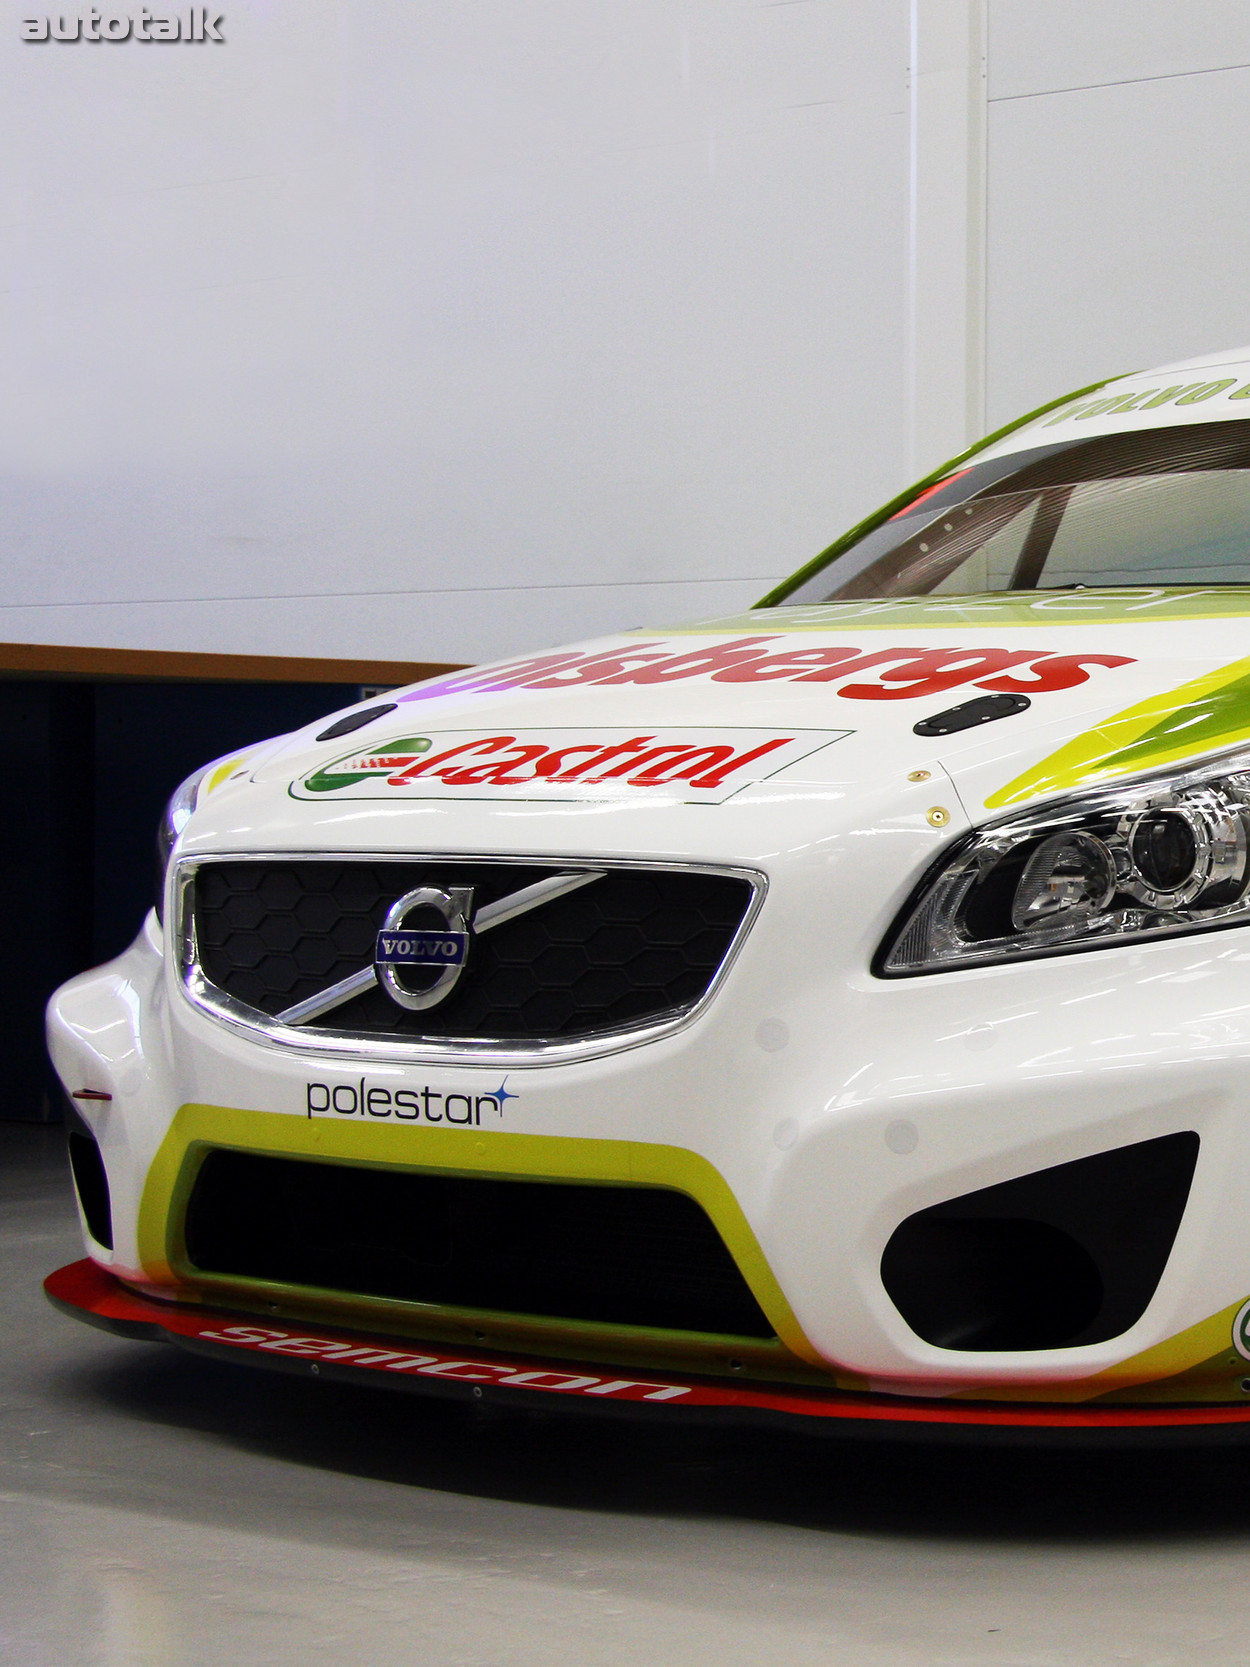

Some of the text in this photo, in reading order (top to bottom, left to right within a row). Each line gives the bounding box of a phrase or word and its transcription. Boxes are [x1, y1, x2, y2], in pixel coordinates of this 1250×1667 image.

[1042, 378, 1238, 428] VOLVO
[397, 636, 1139, 703] Olsbergs
[389, 734, 796, 788] Castrol
[382, 939, 459, 957] VOLVO
[306, 1077, 501, 1126] polestar
[200, 1326, 692, 1400] semcon
